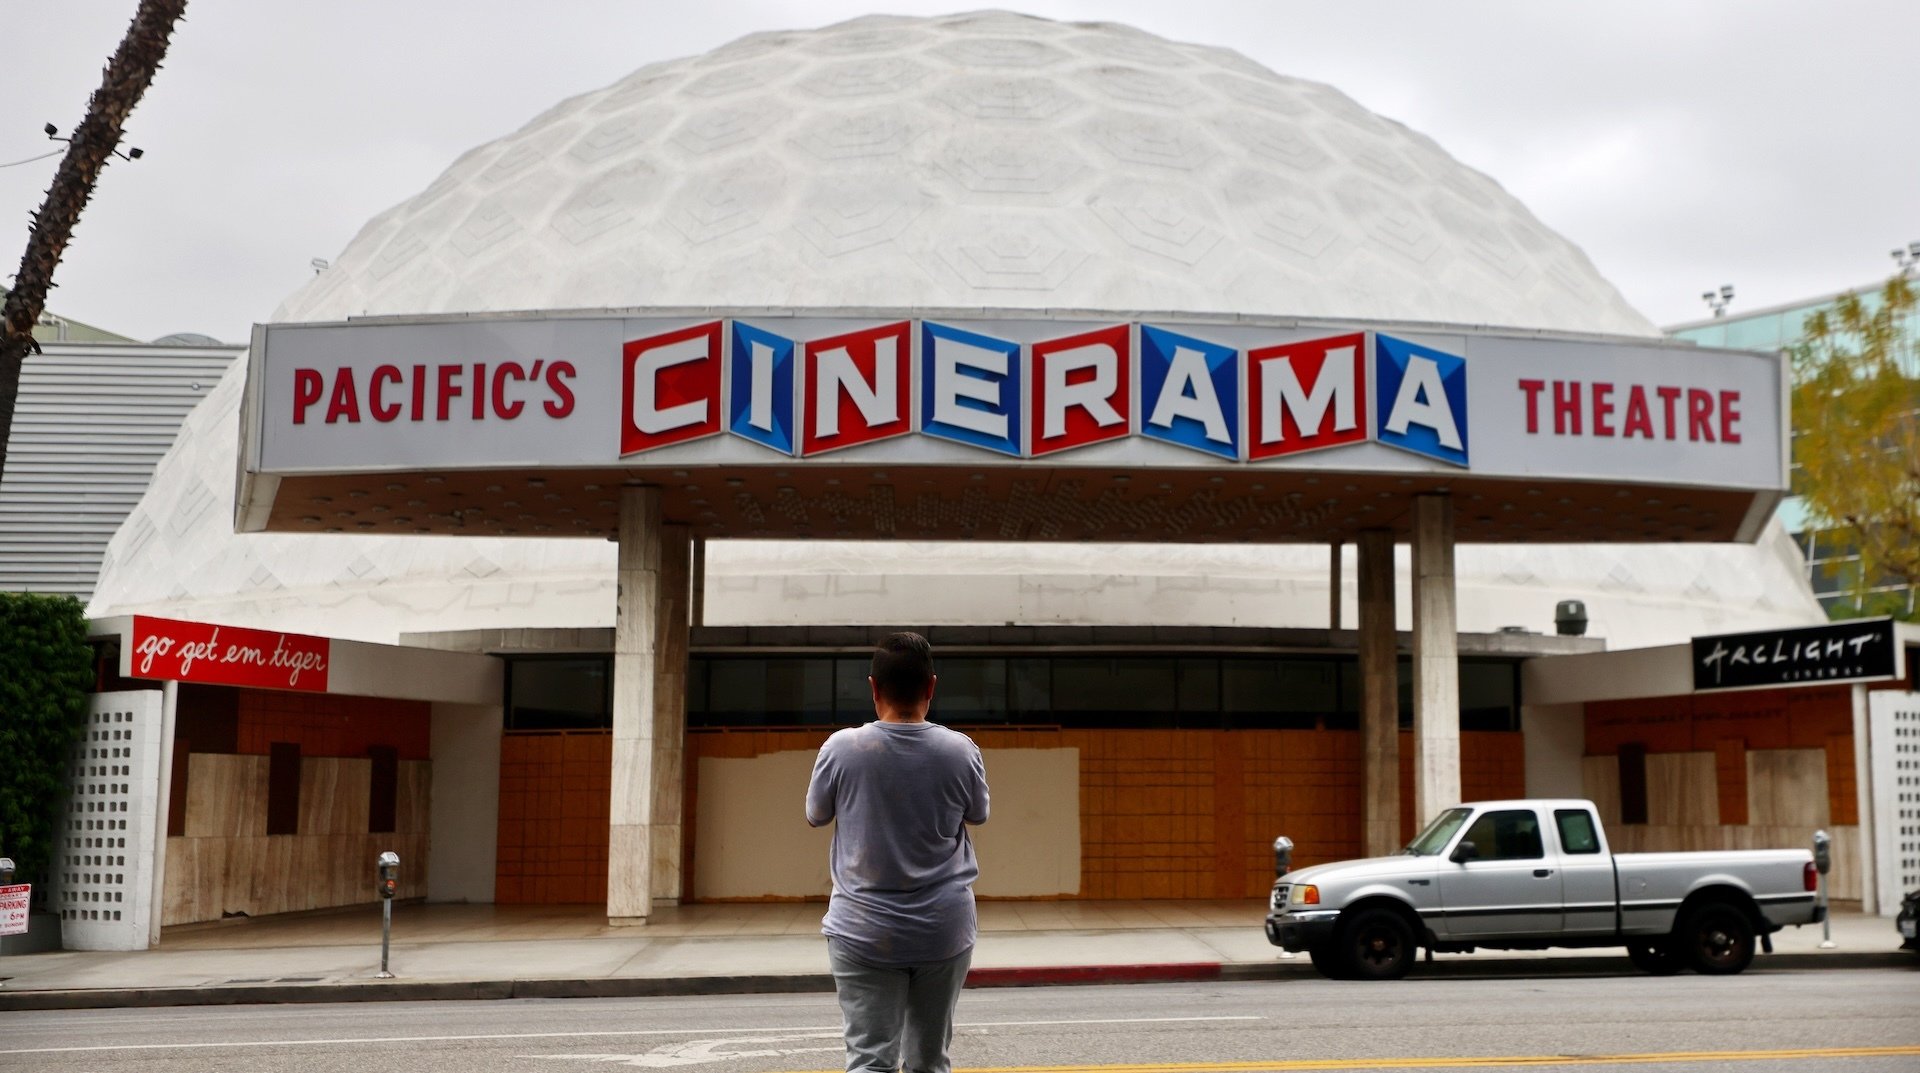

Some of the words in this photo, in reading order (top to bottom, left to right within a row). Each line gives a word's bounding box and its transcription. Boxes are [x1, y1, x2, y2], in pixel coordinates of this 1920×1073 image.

[293, 359, 577, 425] PACIFIC'S
[632, 333, 1465, 452] CINERAMA
[1518, 378, 1742, 445] THEATRE
[136, 634, 176, 674] go
[176, 626, 220, 676] get
[220, 644, 266, 667] em
[269, 634, 326, 687] tiger
[1703, 633, 1874, 684] ARCLIGHT
